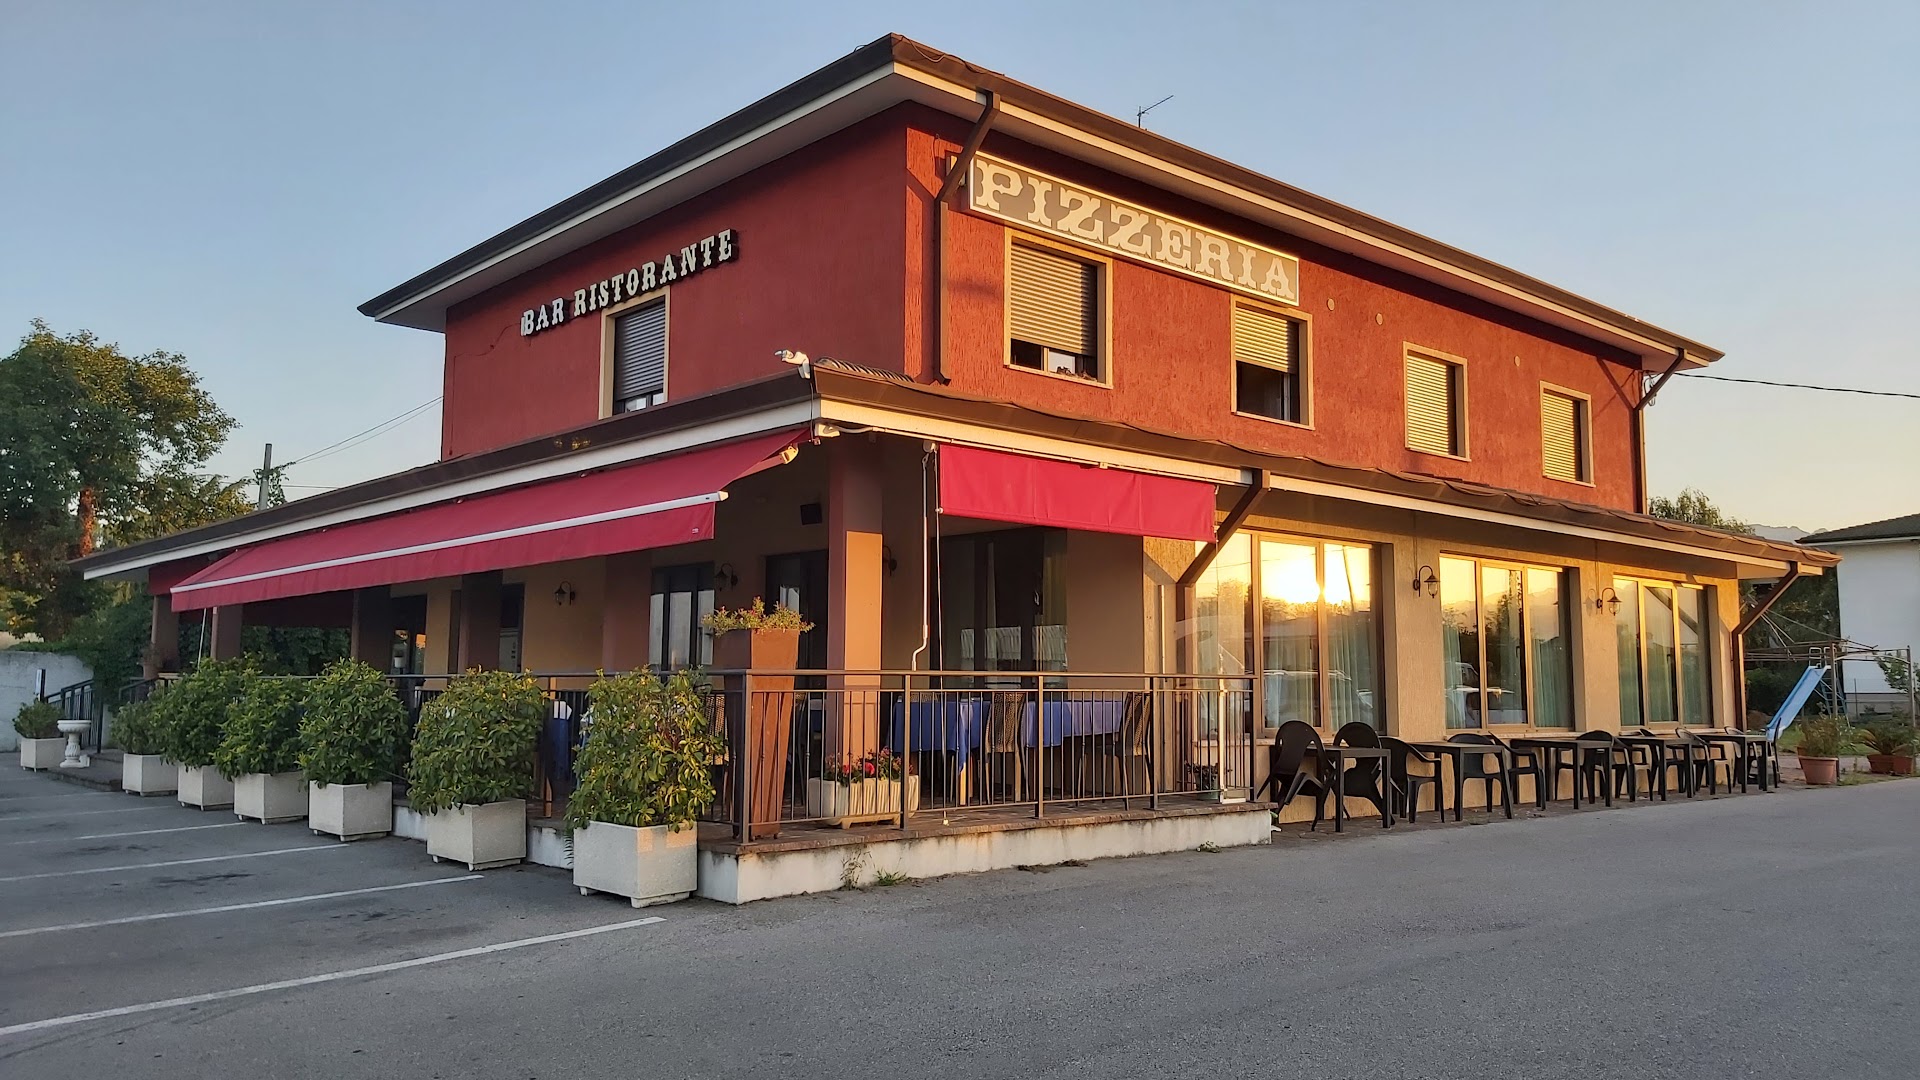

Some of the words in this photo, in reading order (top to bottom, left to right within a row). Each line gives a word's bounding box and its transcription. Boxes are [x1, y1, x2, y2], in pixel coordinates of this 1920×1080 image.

[521, 297, 565, 336] BAR
[573, 228, 733, 317] RISTORANTE
[976, 159, 1295, 298] PIZZERIA
